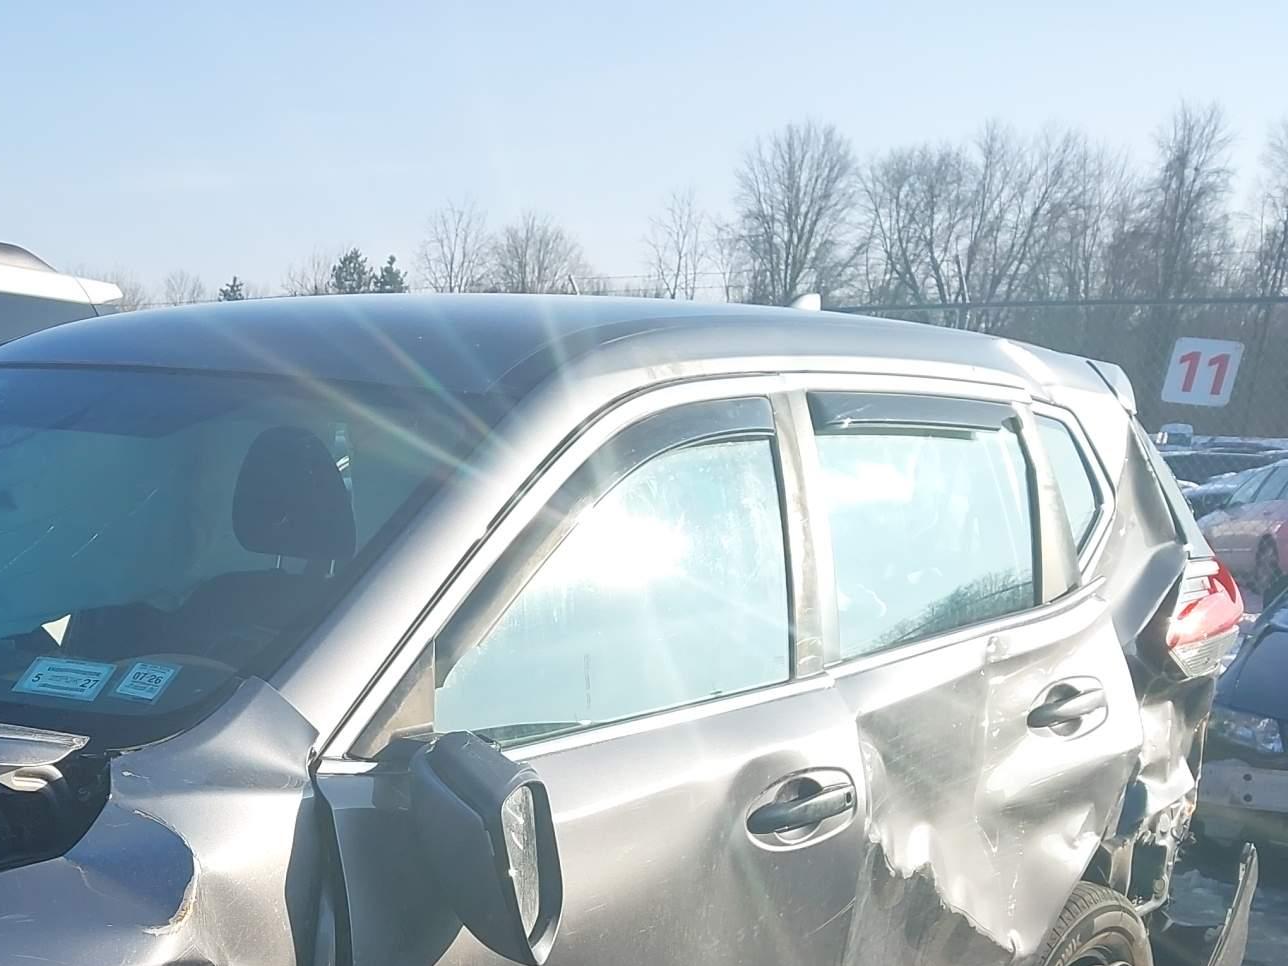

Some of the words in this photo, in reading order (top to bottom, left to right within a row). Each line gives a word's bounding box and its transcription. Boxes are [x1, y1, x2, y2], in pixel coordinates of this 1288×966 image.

[1179, 350, 1232, 396] 11
[31, 673, 43, 683] 5
[79, 678, 100, 689] 27
